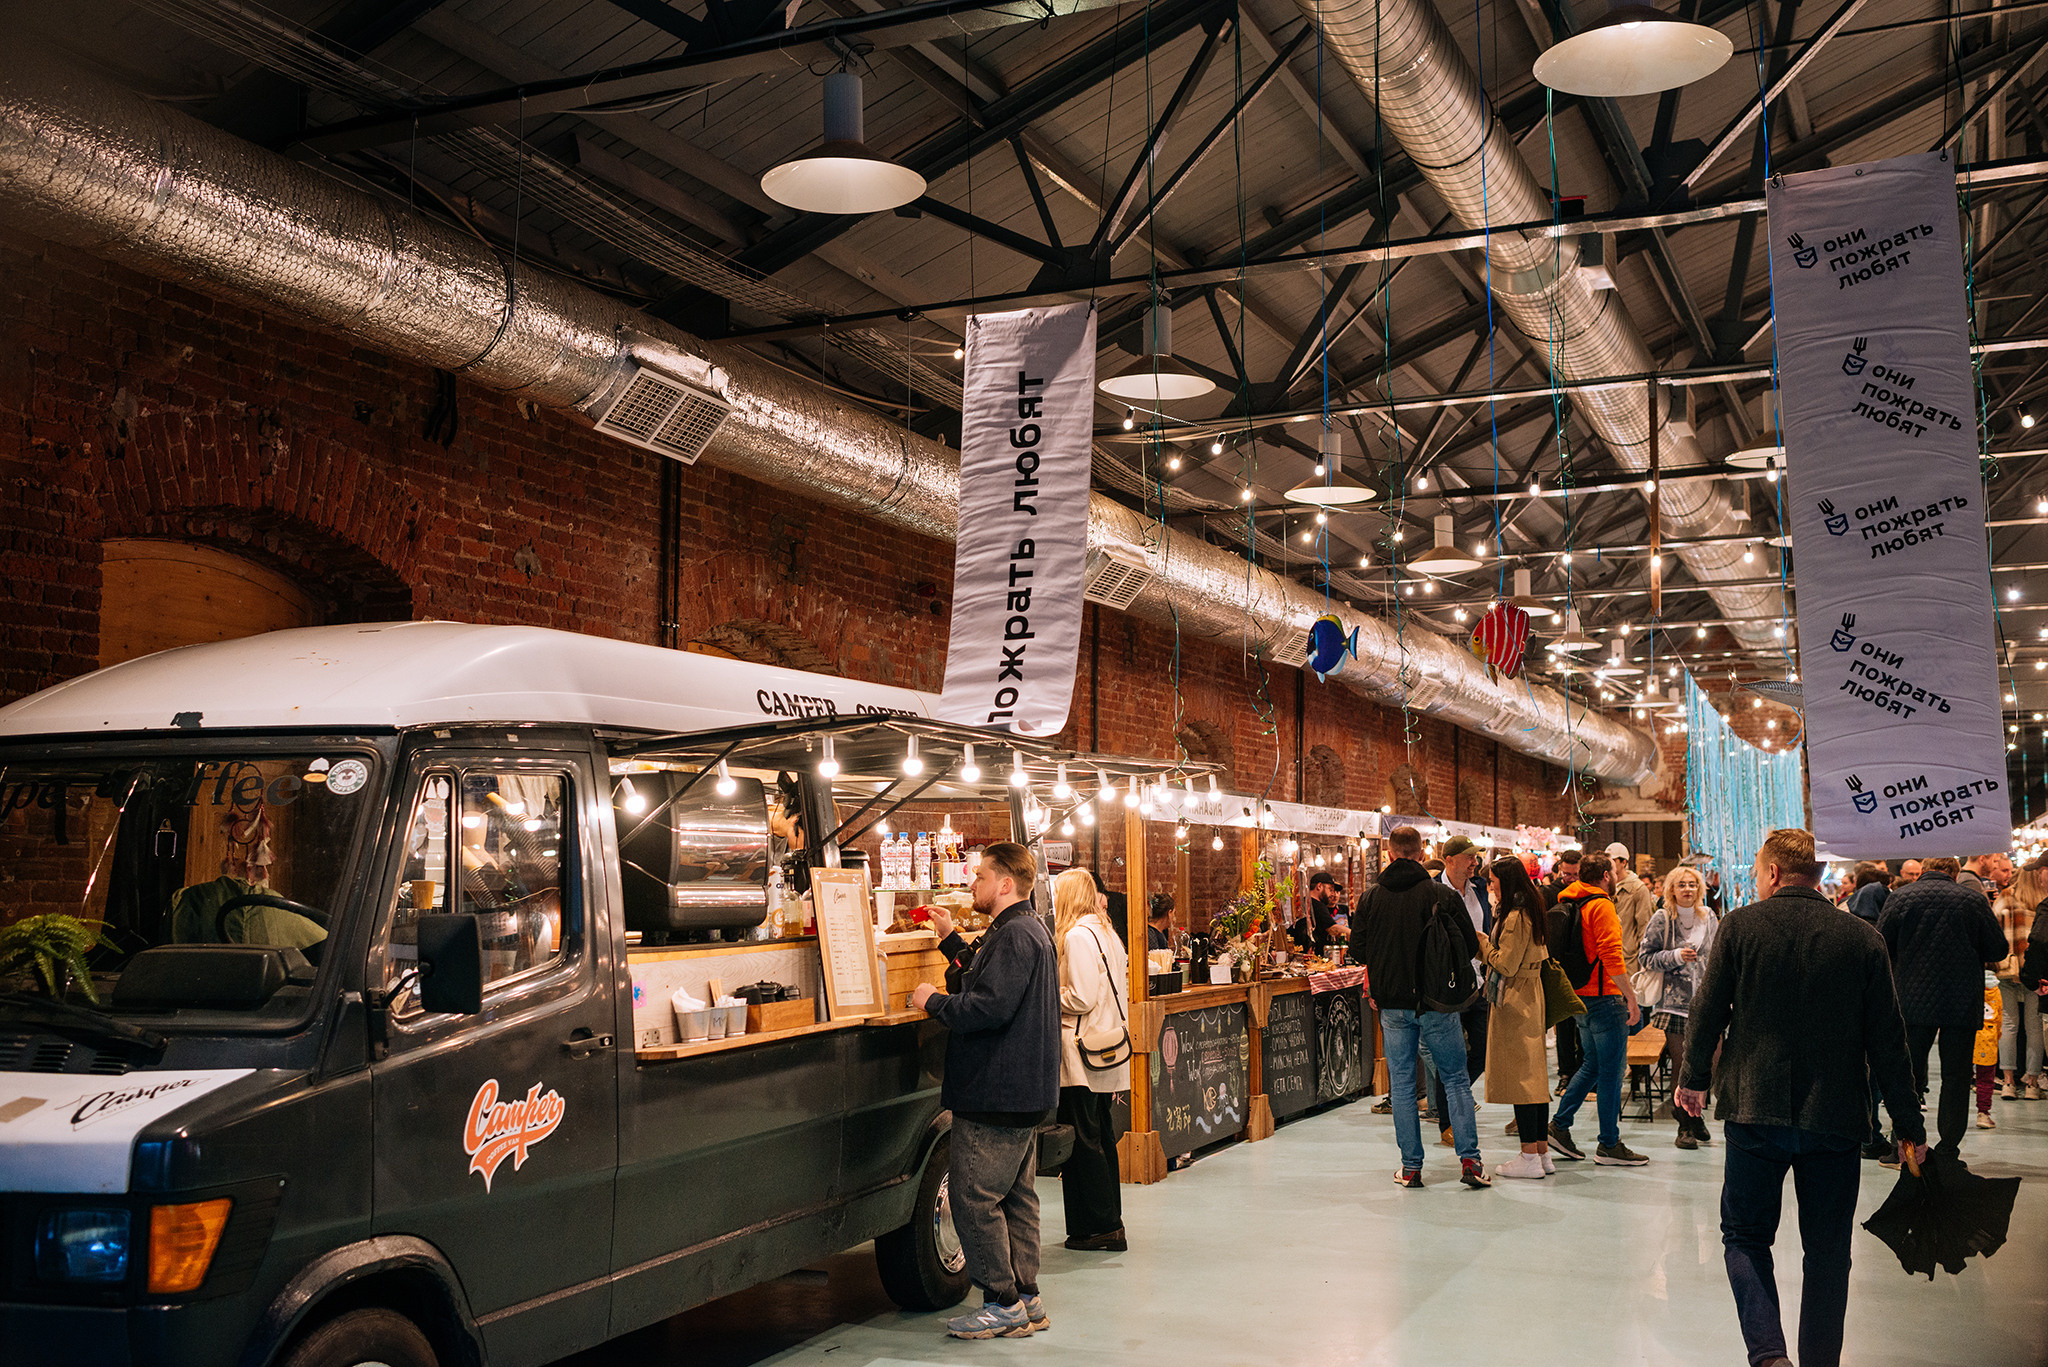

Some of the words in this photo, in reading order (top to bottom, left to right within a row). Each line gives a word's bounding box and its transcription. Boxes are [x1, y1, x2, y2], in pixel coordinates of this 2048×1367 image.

[1823, 227, 1867, 253] они
[1829, 223, 1934, 272] пожрать
[1838, 250, 1911, 291] любят
[1872, 365, 1916, 390] они
[1851, 401, 1928, 438] любят
[1860, 382, 1962, 431] пожрать
[1009, 371, 1044, 516] любят
[1854, 495, 1900, 521] они
[1860, 495, 1968, 541] пожрать
[1870, 522, 1945, 560] любят
[1860, 642, 1905, 670] они
[757, 689, 839, 718] CAMPER
[1839, 679, 1917, 720] любят
[1849, 659, 1952, 714] пожрать
[1882, 774, 1929, 799] они
[1889, 778, 1999, 820] пожрать
[1899, 804, 1975, 840] любят
[69, 1079, 193, 1125] Camper
[464, 1079, 566, 1160] Camper
[487, 1141, 508, 1164] COFFEE
[507, 1137, 520, 1148] VAN
